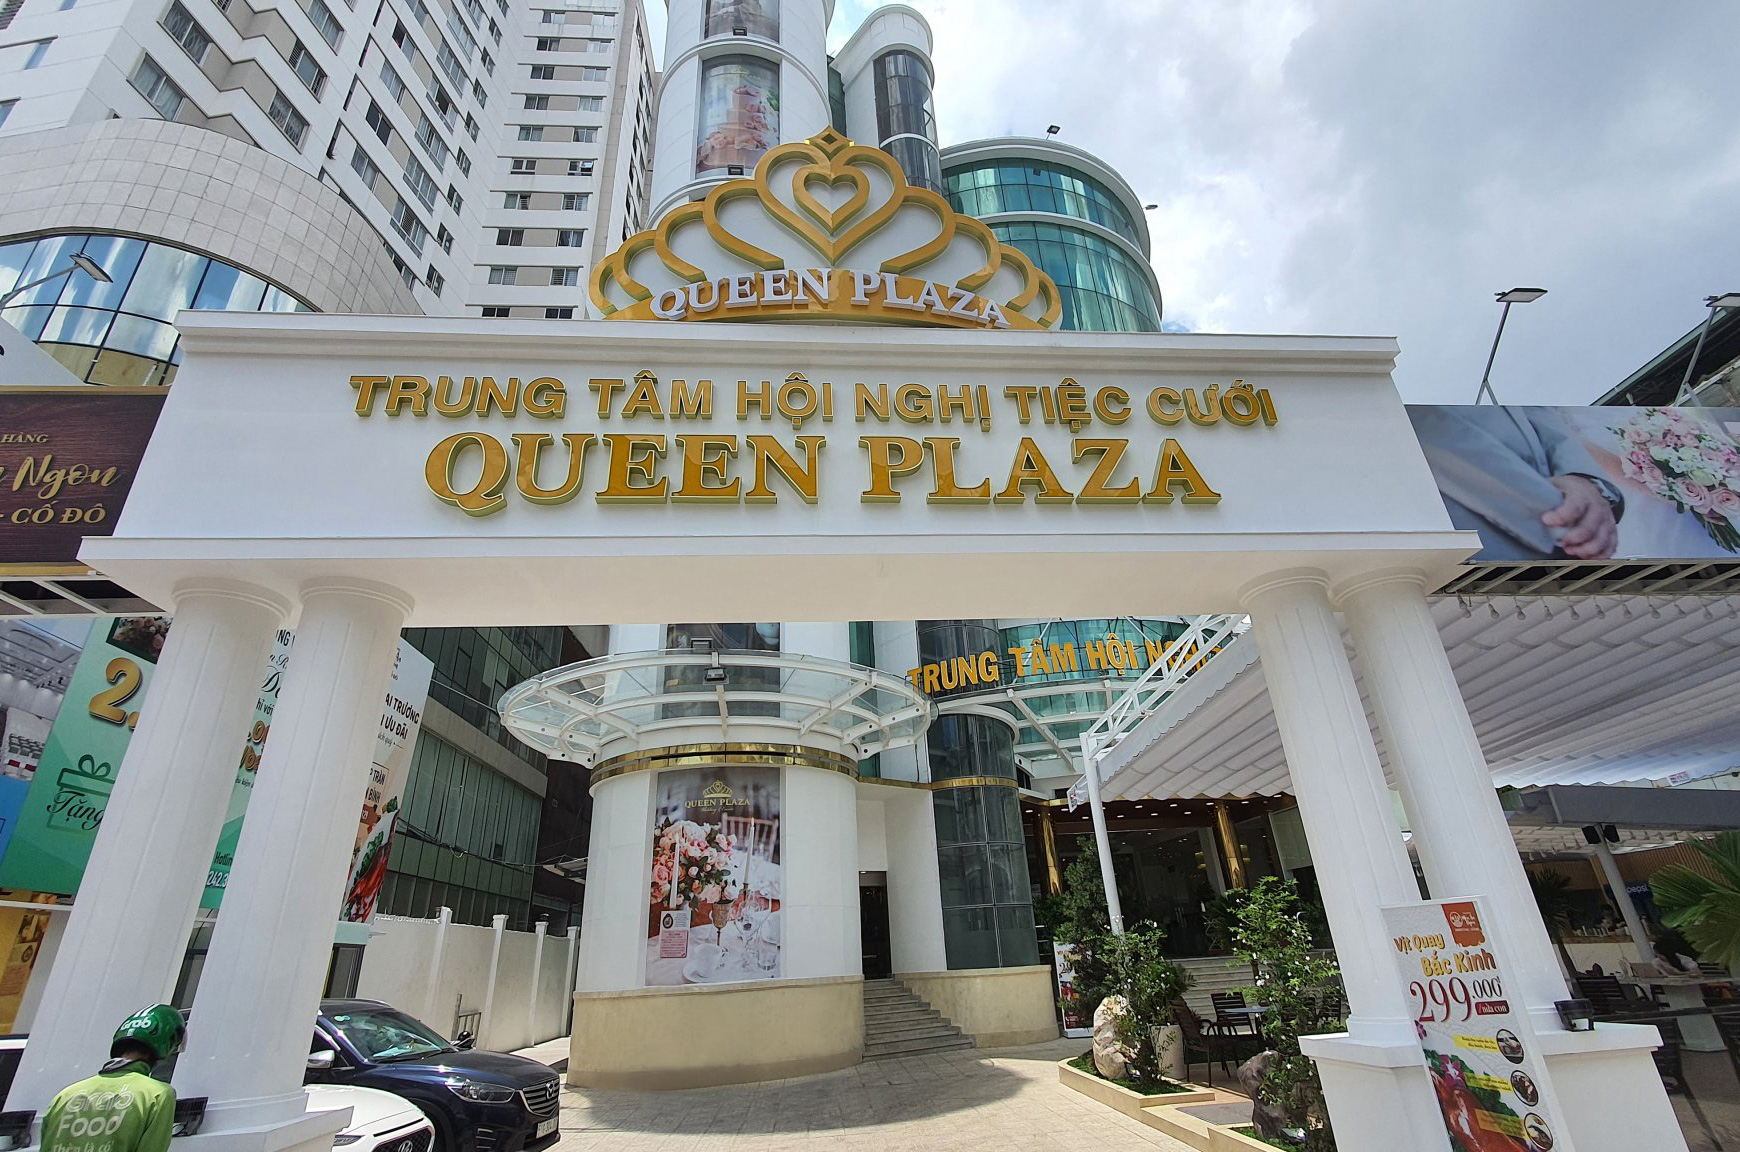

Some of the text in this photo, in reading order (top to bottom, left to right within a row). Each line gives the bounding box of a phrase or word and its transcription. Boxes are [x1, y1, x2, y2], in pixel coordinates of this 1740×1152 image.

[650, 267, 1011, 330] QUEEN PLAZA
[349, 369, 1279, 433] TRUNG TÂM HỘI NGHỊ TIỆC CƯỚI
[12, 454, 121, 500] Ngon
[424, 431, 1223, 517] QUEEN PLAZA
[11, 500, 106, 524] CỐ ĐÔ
[906, 650, 1000, 694] TRUNG
[1008, 638, 1077, 677] TÂM
[1084, 632, 1138, 676] HỘI
[684, 798, 751, 809] QUEEN PLAZA
[1412, 933, 1446, 953] Quay
[1453, 947, 1497, 974] Kinh
[119, 1016, 153, 1032] Grab
[65, 1083, 135, 1113] Grab
[55, 1110, 127, 1139] Food
